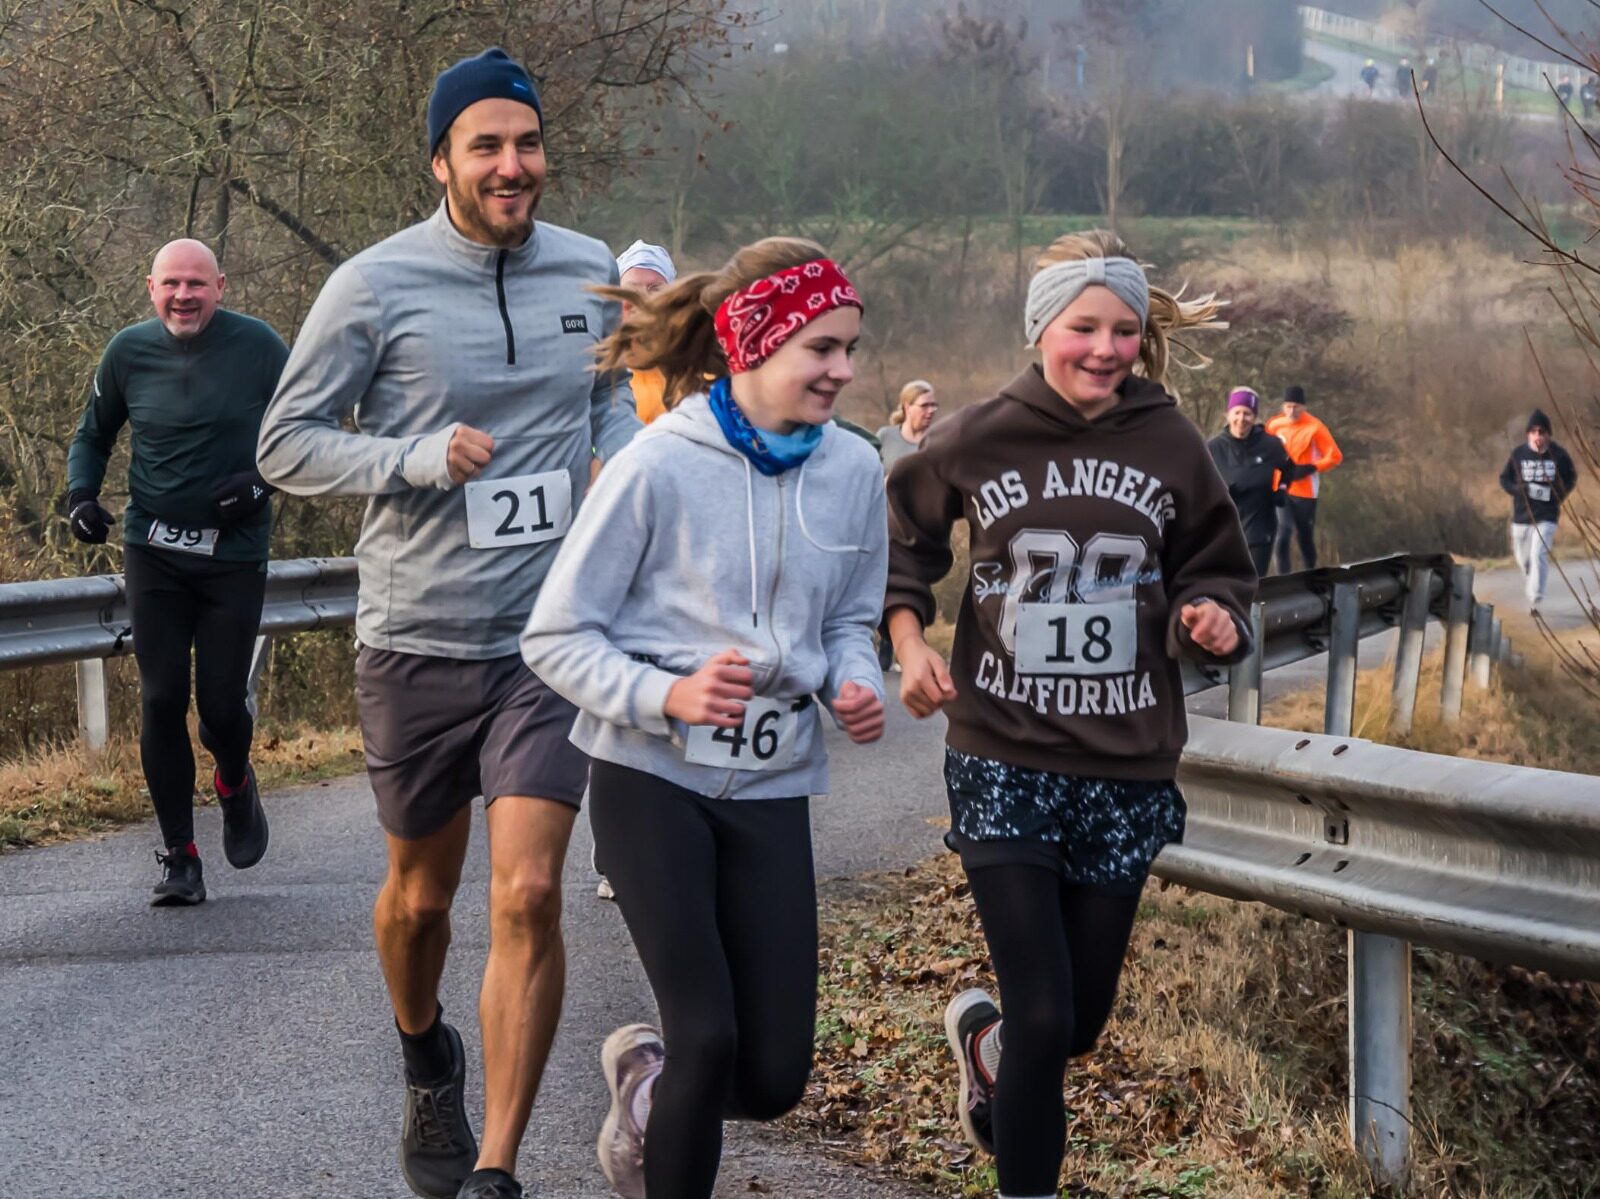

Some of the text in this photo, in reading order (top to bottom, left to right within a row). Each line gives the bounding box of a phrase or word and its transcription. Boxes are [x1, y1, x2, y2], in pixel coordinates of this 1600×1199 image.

[491, 485, 554, 537] 21
[971, 470, 1029, 530] LOS
[163, 522, 203, 547] 99
[1045, 615, 1113, 665] 18
[975, 650, 1157, 715] CALIFORNIA
[711, 709, 781, 760] 46
